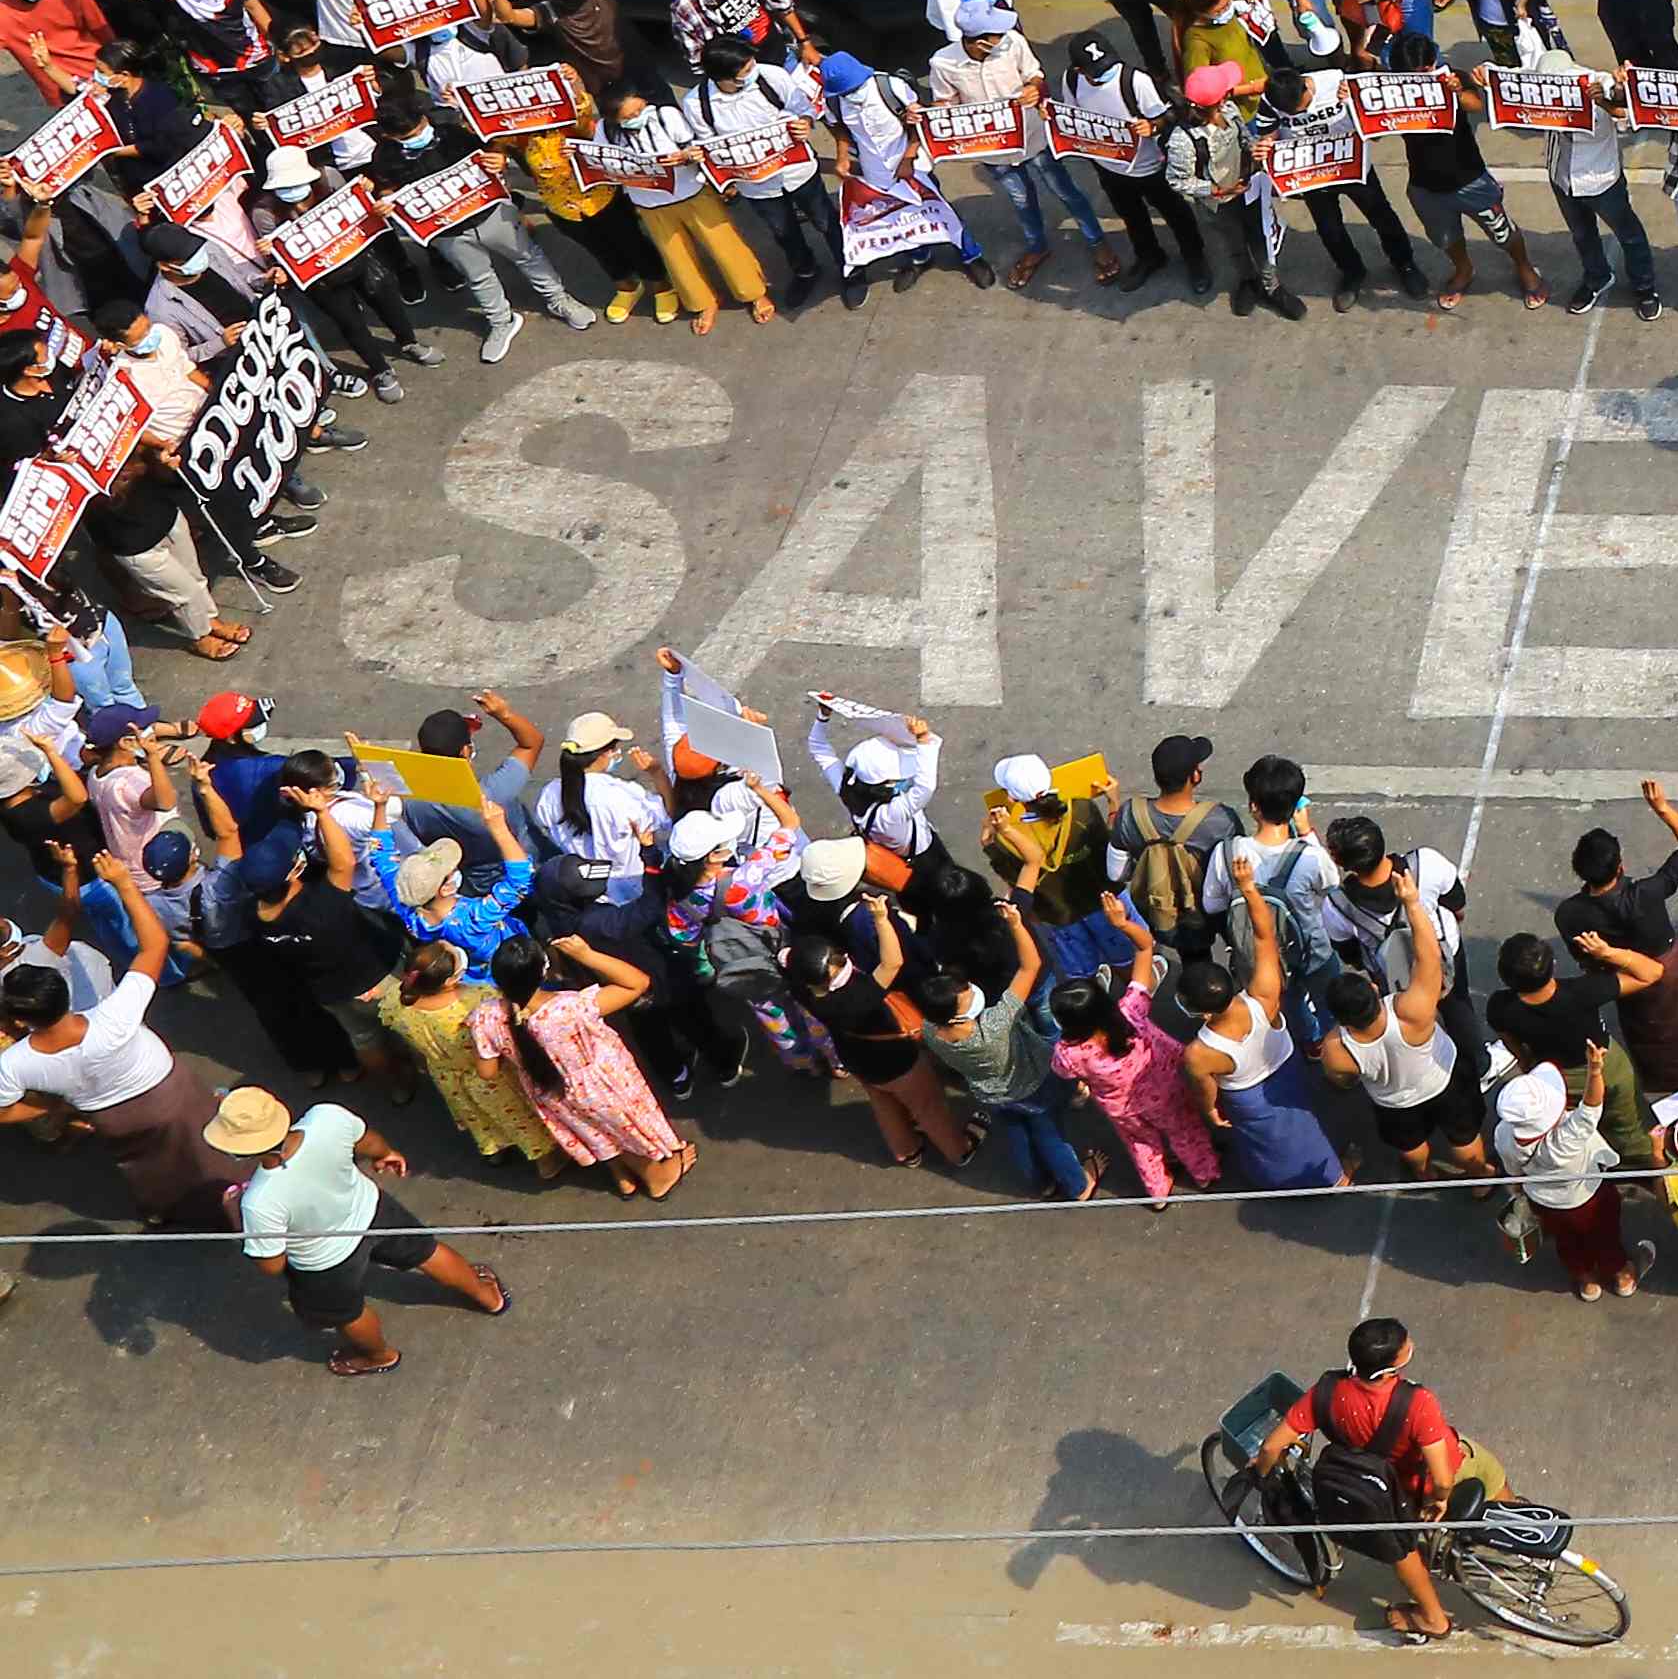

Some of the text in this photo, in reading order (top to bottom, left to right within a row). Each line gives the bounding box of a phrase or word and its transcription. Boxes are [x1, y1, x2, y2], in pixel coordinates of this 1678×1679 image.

[281, 84, 362, 134] CRPH
[474, 85, 562, 114] CRPH
[927, 100, 1010, 120] WE SUPPORT
[1360, 82, 1444, 110] CRPH
[1503, 81, 1582, 108] CRPH
[931, 106, 1017, 139] CRPH
[1059, 115, 1133, 143] CRPH
[1281, 102, 1343, 128] RAIDERS
[22, 112, 100, 180] CRPH
[710, 133, 791, 167] CRPH
[1274, 139, 1352, 171] CRPH
[161, 130, 233, 207] CRPH
[405, 165, 489, 219] CRPH
[285, 192, 366, 259] CRPH
[82, 384, 137, 467] CRPH
[13, 469, 71, 554] CRPH
